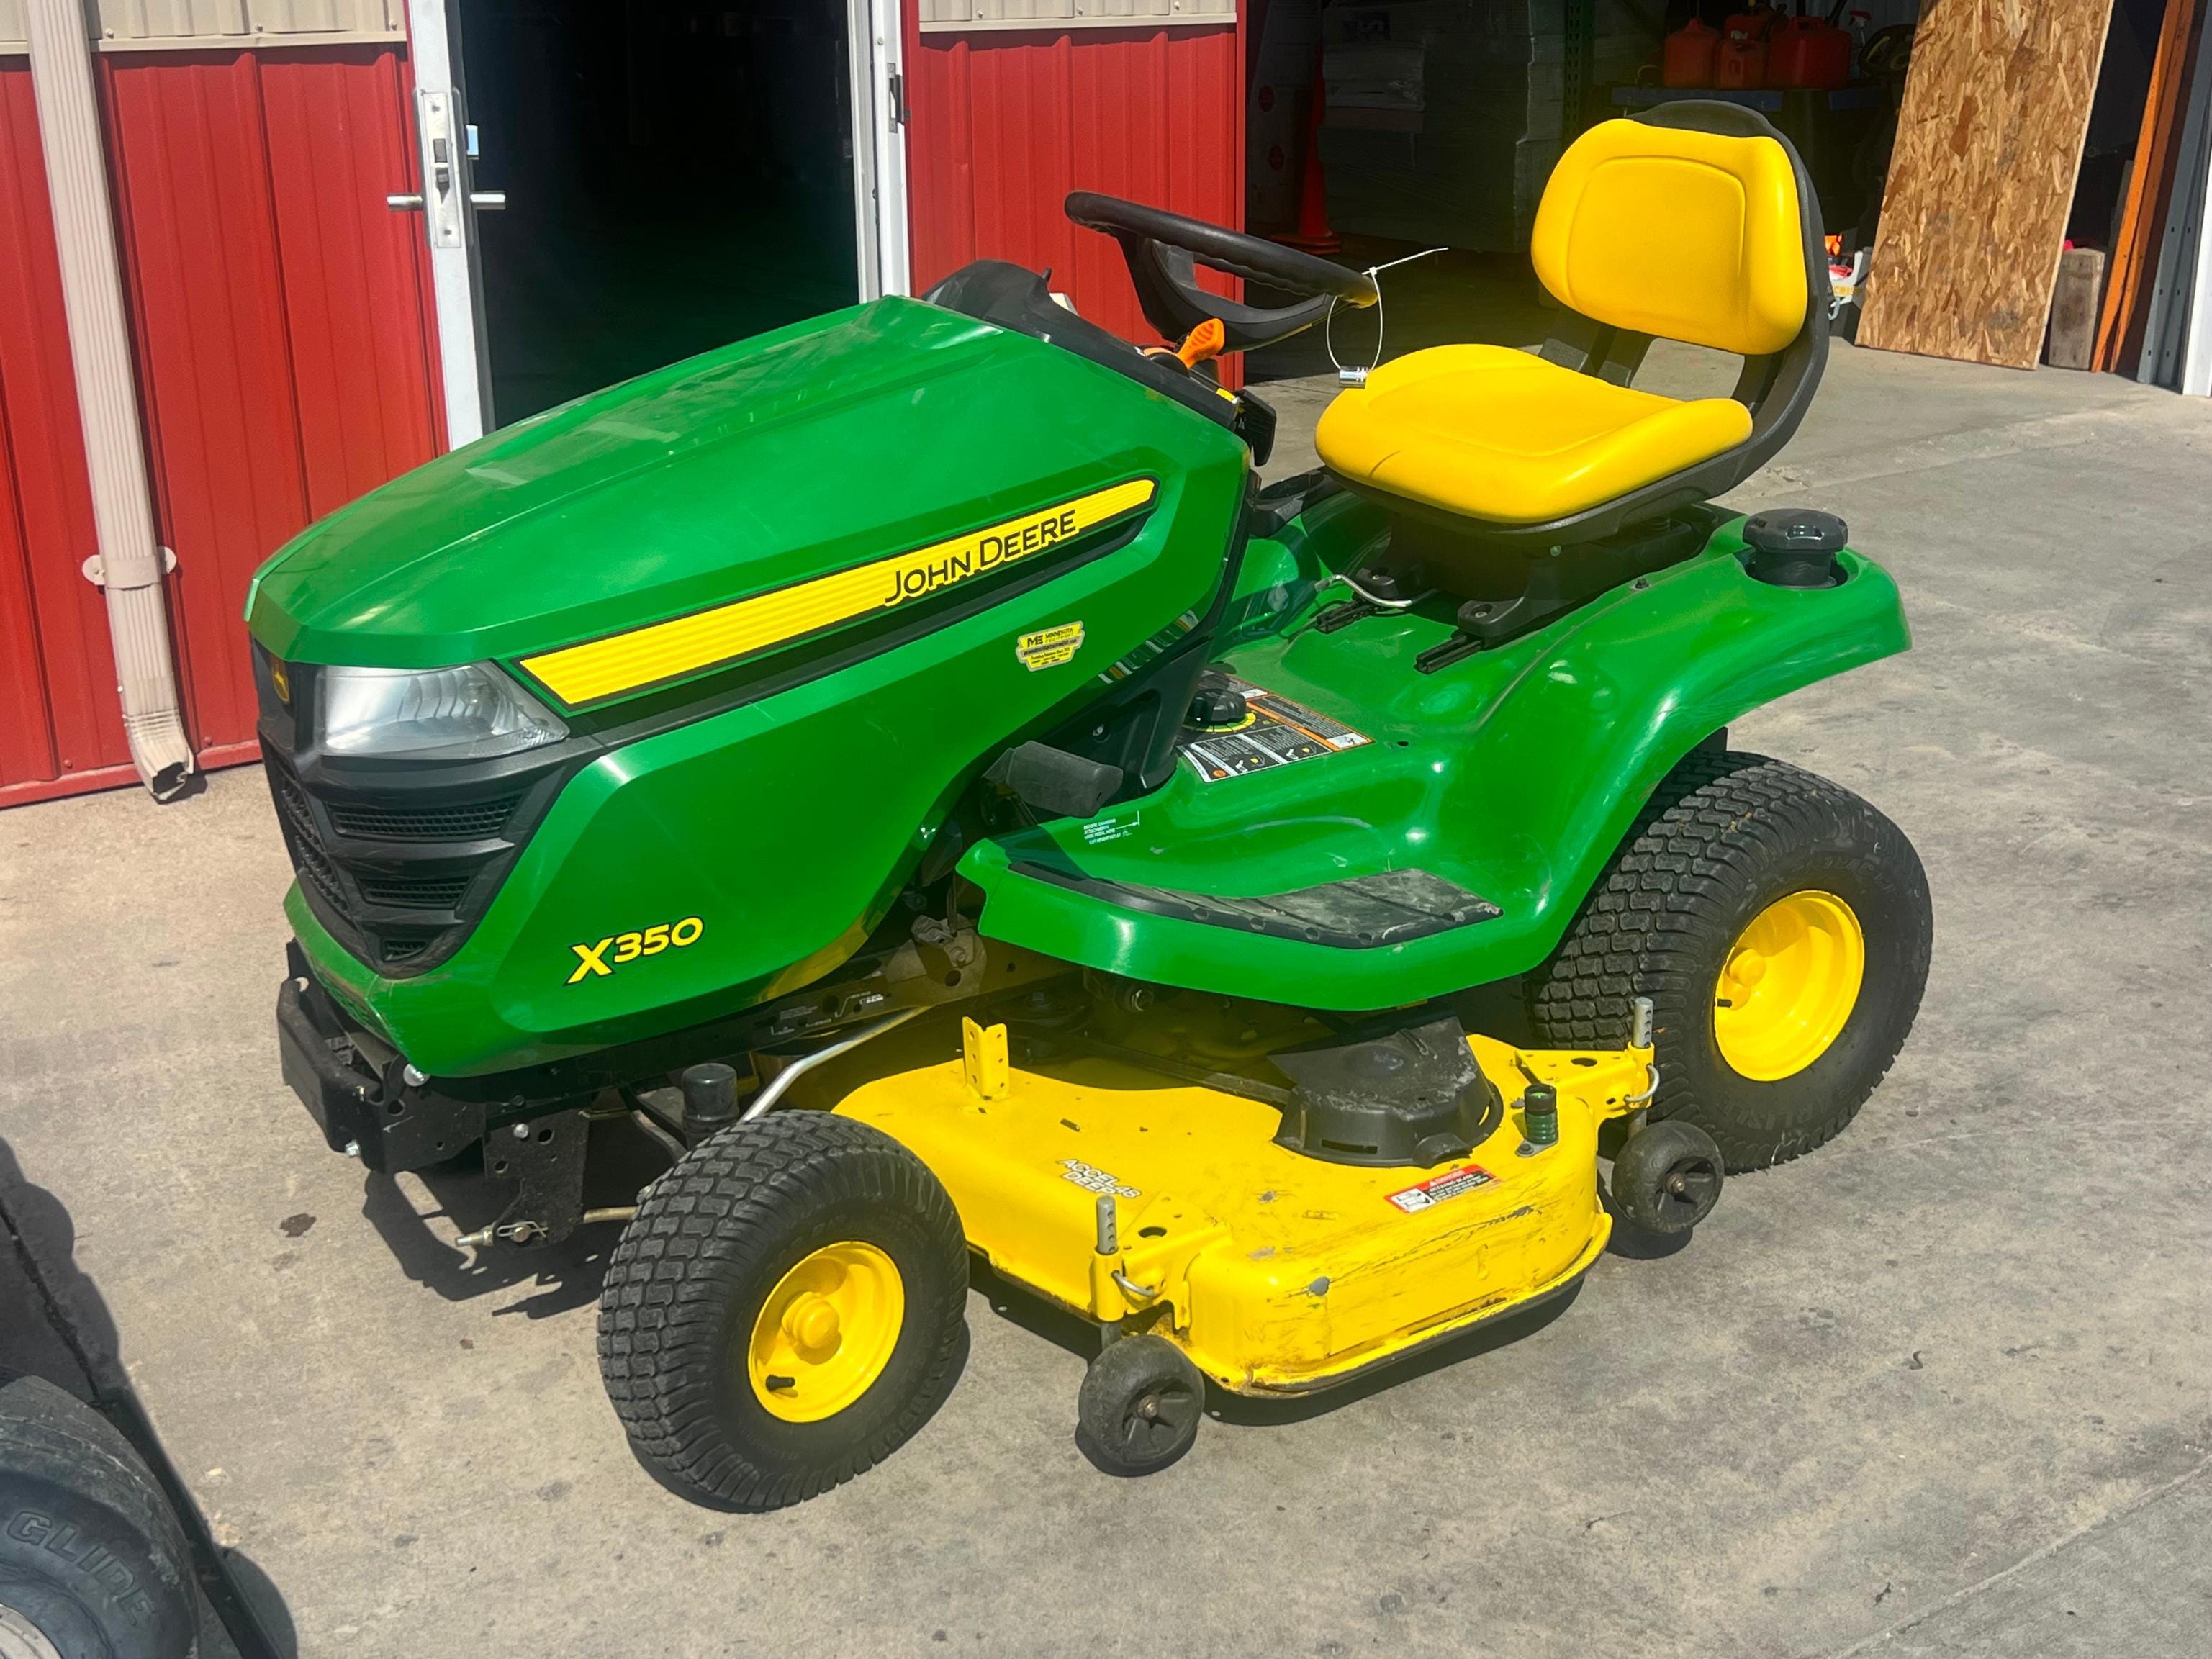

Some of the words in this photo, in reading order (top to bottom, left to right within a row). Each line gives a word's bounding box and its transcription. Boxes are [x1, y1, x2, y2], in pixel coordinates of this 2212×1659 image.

[885, 550, 971, 603] JOHN
[980, 509, 1077, 566] DEERE
[1027, 634, 1043, 647] ME
[1045, 628, 1073, 638] MINNESOTA
[565, 916, 705, 985] X350
[1055, 1159, 1120, 1189] ACCEL
[1060, 1170, 1117, 1195] DEEP
[7, 1511, 155, 1627] GLIDE
